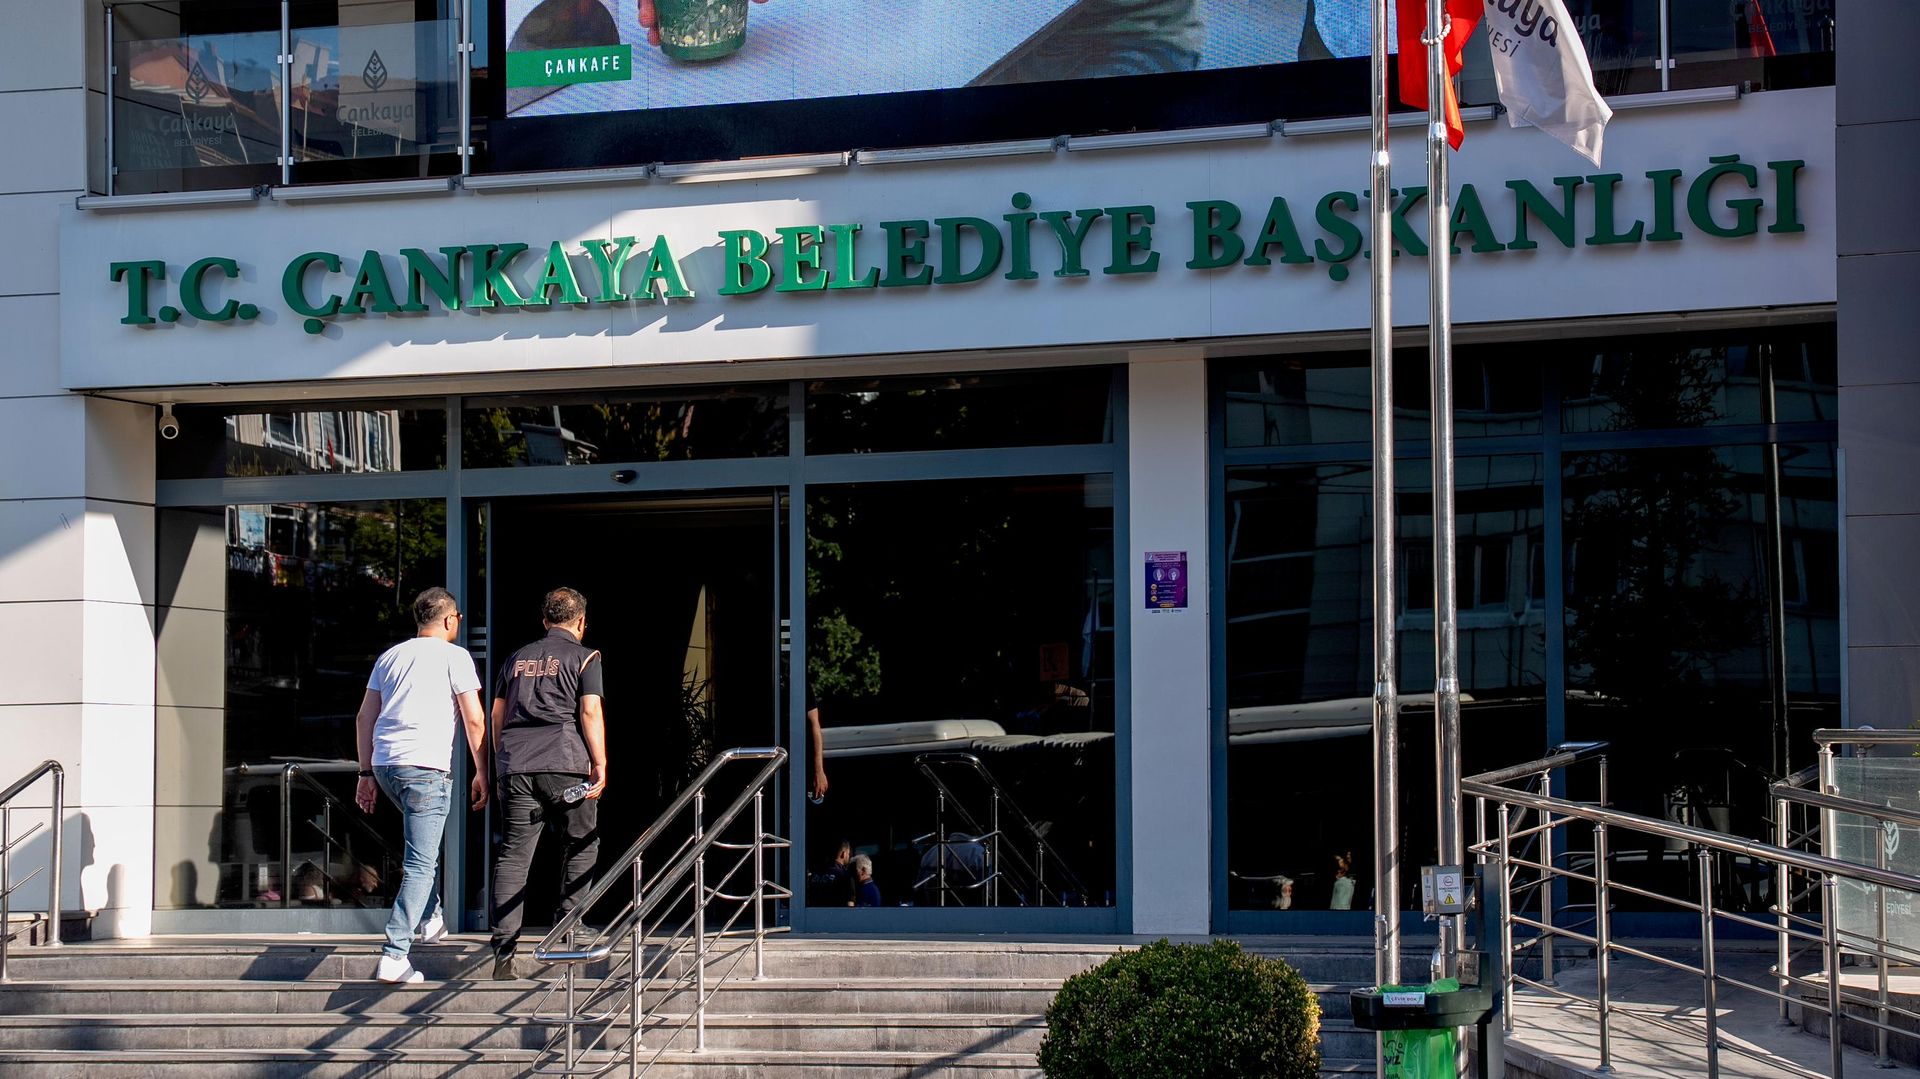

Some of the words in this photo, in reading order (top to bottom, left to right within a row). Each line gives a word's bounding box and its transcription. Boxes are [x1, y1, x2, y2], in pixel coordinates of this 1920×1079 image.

[545, 55, 620, 77] ÇANKAFE
[110, 257, 259, 325] T.C.
[282, 235, 696, 334] ÇANKAYA
[717, 192, 1161, 297] BELEDİYE
[1186, 154, 1805, 282] BAŞKANLIĞI
[514, 656, 560, 677] POLİS
